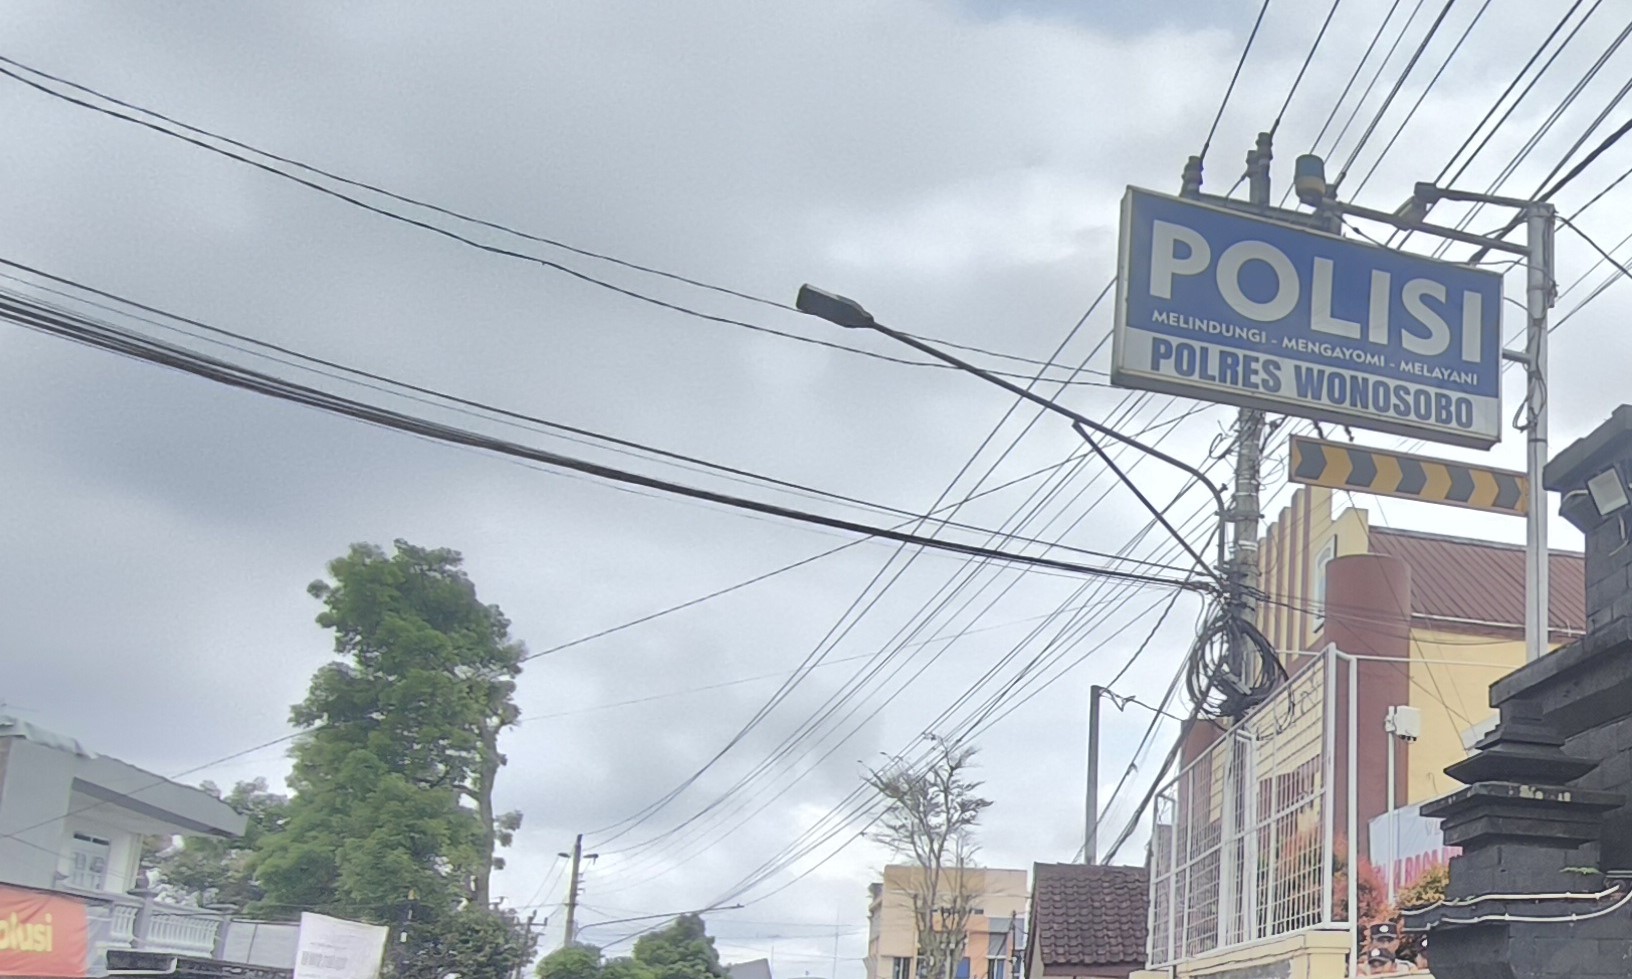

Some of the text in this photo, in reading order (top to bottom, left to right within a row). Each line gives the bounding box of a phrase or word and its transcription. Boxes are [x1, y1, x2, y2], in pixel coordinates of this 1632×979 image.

[1150, 219, 1482, 363] POLISI
[1151, 336, 1473, 429] POLRES WONOSOBO
[1152, 308, 1478, 386] MELINDUNGI MENGAYOMI MELAYANI
[0, 911, 53, 952] olusi
